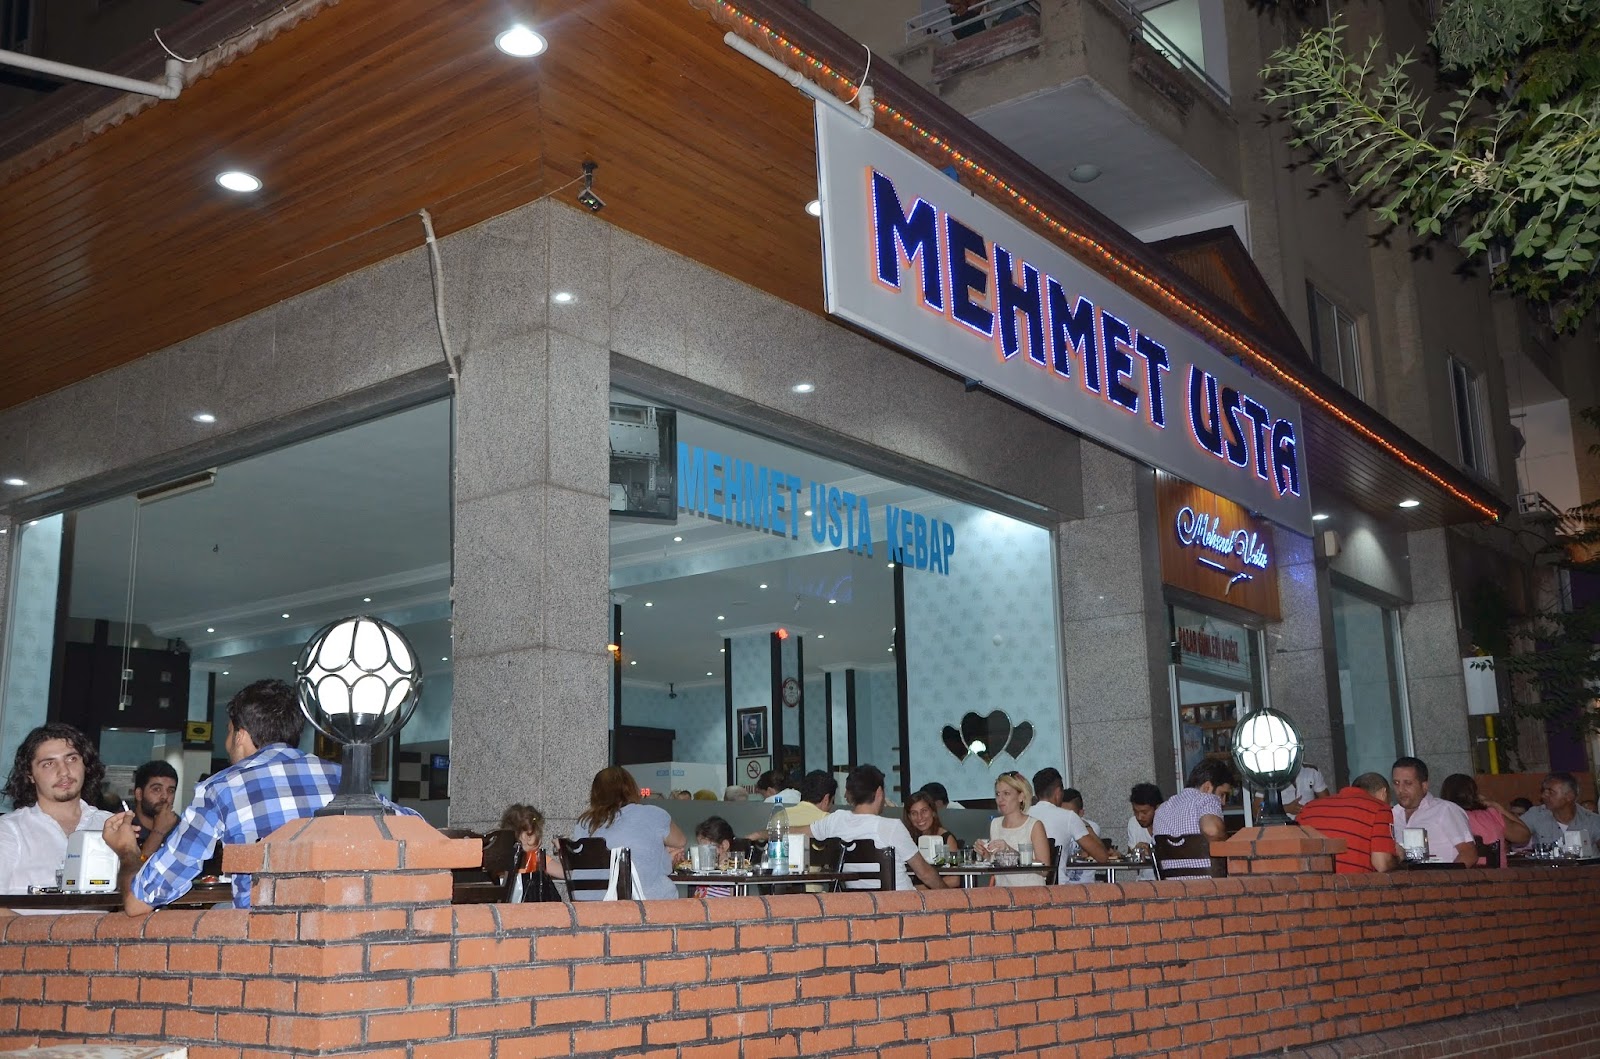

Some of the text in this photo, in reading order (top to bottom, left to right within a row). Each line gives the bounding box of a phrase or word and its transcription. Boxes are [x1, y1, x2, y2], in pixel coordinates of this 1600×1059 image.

[867, 167, 1301, 498] MEHMET USTA
[677, 441, 955, 576] MEHMET USTA KEBAP
[1177, 506, 1236, 554] Mehmet
